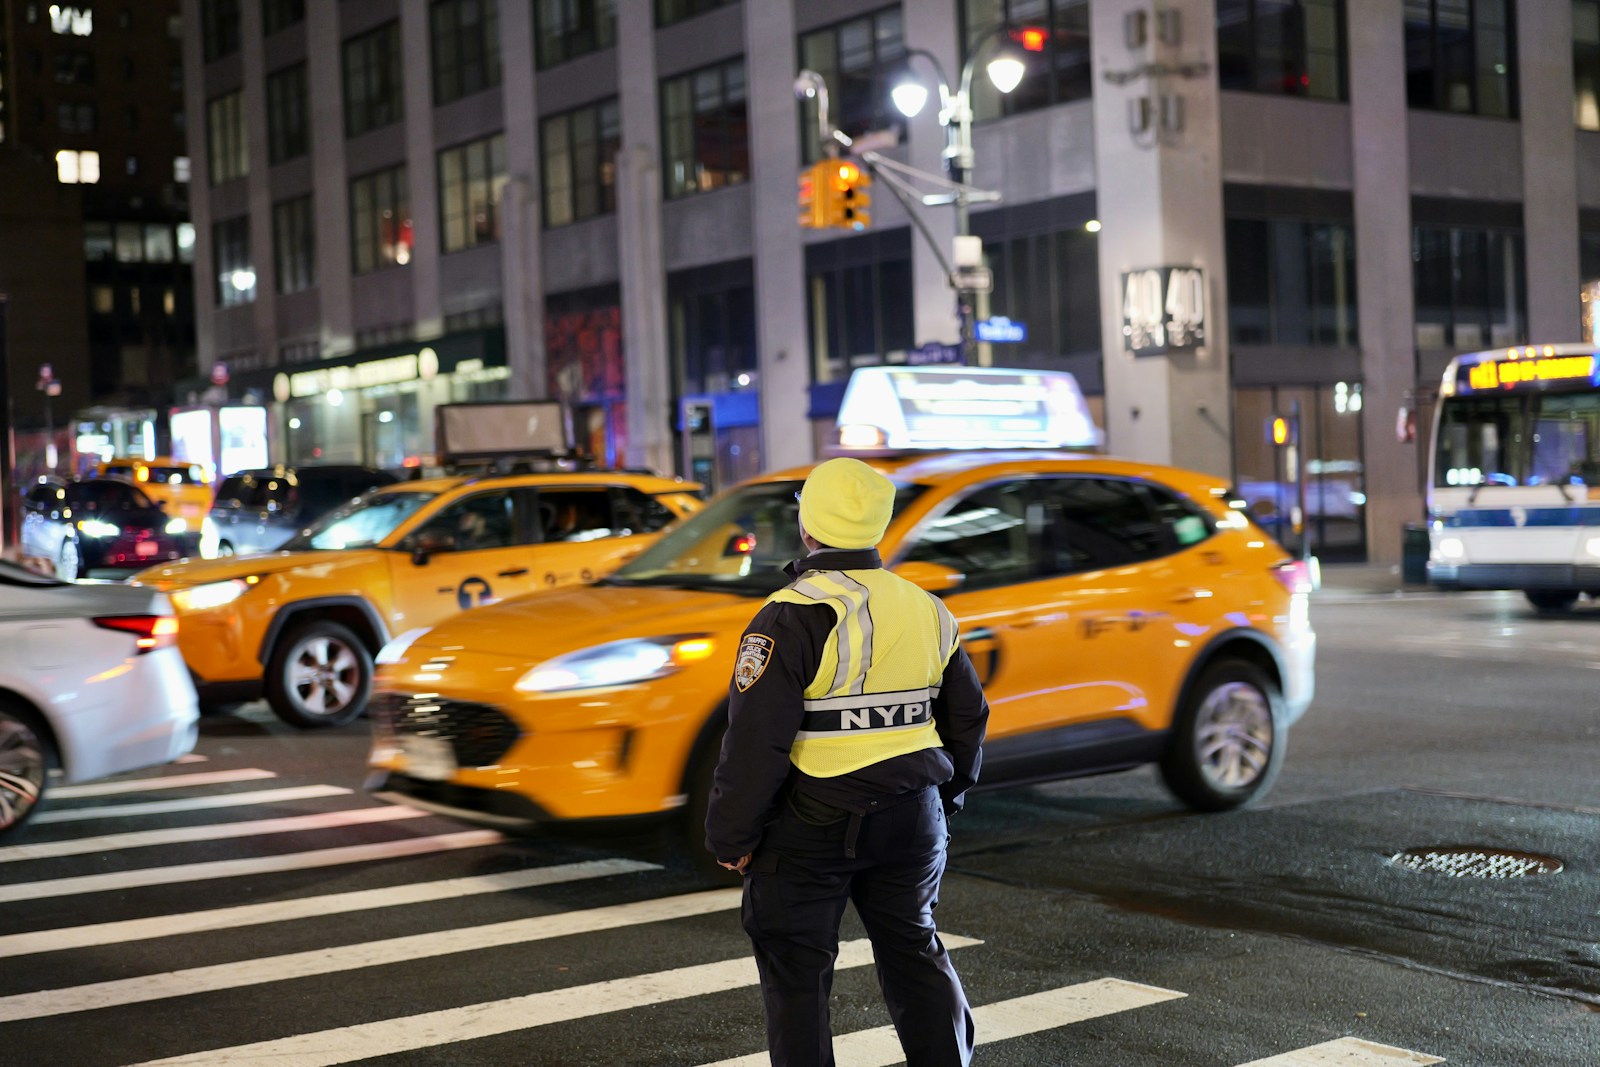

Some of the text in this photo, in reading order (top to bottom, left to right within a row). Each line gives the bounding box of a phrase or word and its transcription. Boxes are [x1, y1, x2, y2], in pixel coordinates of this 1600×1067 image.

[747, 636, 767, 646] TRAFFIC
[746, 645, 762, 654] POLICE
[840, 700, 931, 730] NYP
